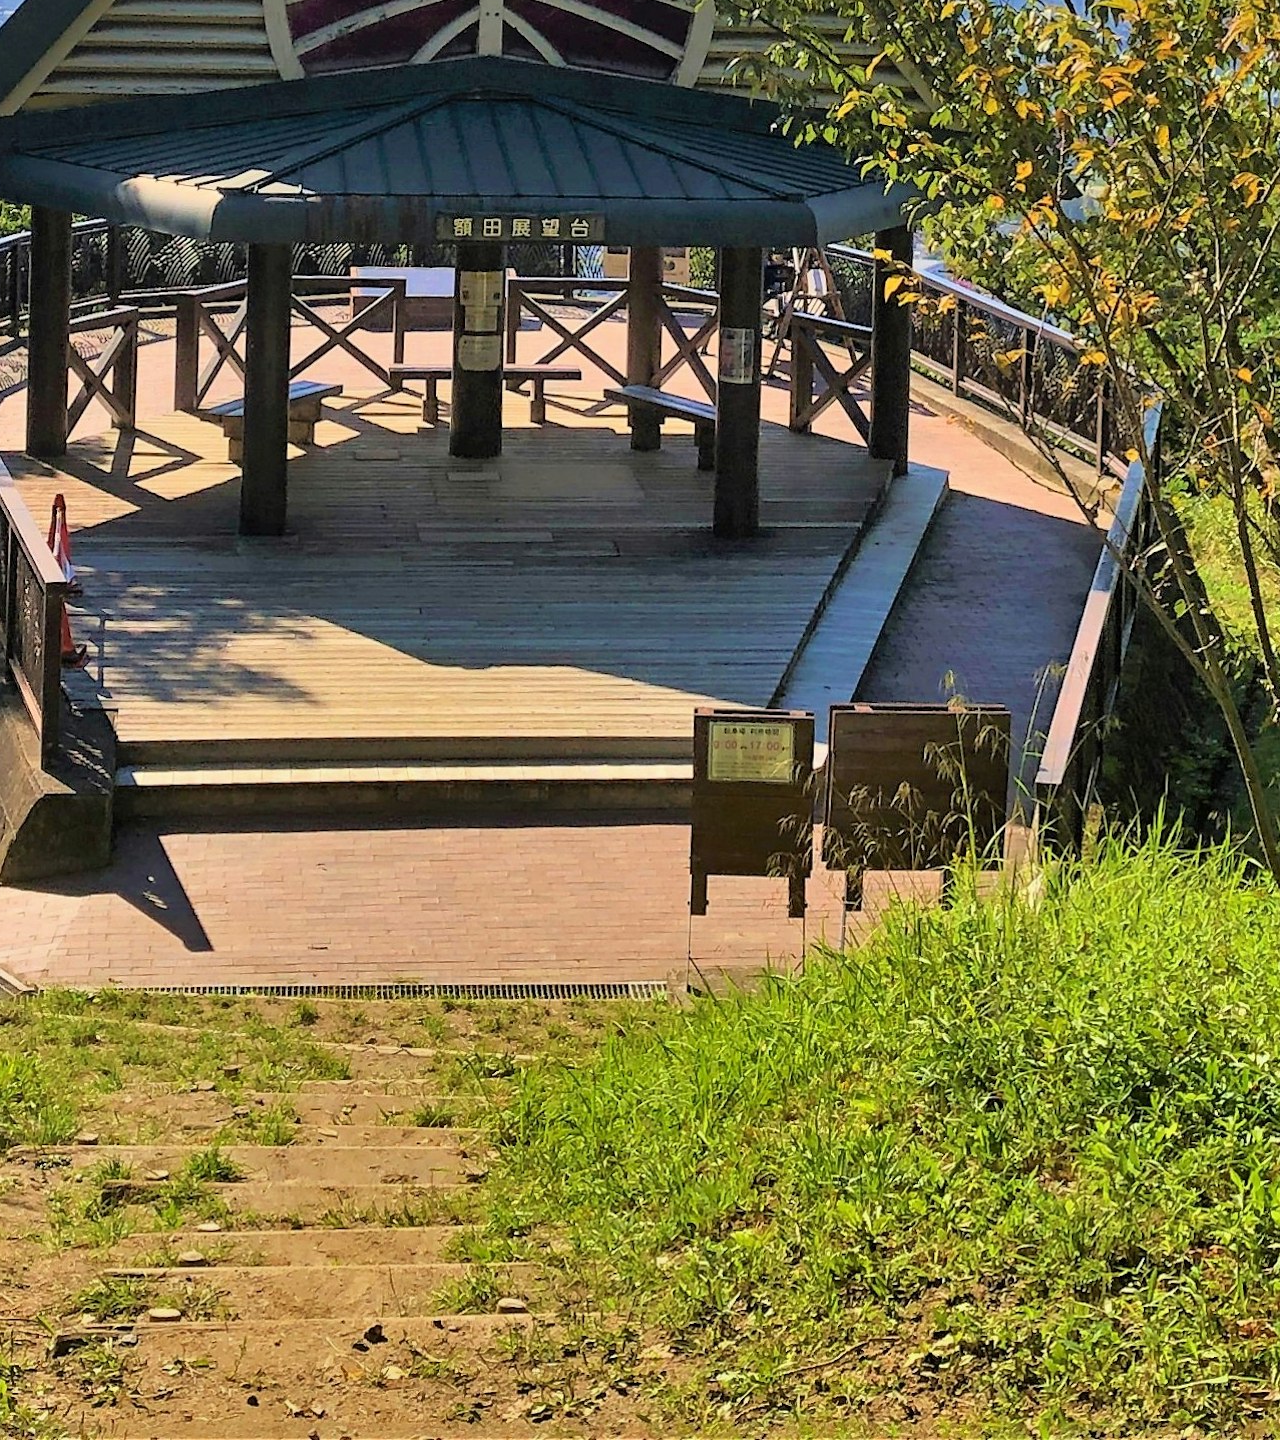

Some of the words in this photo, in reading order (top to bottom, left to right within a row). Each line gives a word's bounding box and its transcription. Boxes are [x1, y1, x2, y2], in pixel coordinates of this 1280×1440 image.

[453, 218, 589, 237] 額田展望台
